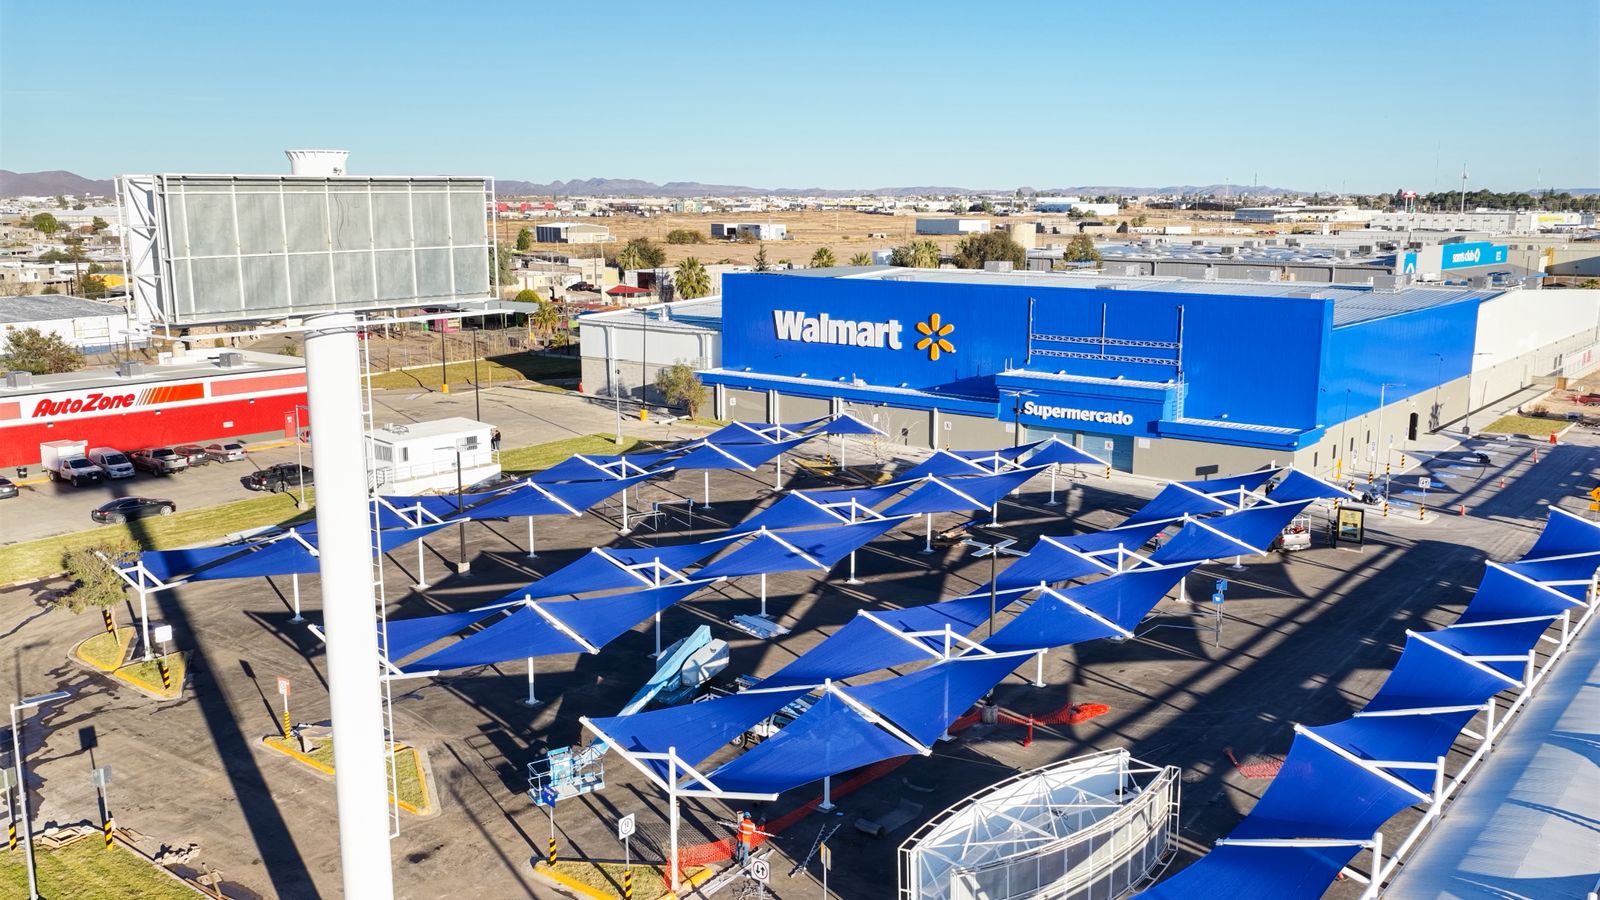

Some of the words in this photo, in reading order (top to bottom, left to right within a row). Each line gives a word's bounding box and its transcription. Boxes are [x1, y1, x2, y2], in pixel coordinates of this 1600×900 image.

[773, 310, 903, 350] Walmart
[32, 393, 136, 418] AutoZone
[1024, 401, 1134, 426] Supermercado
